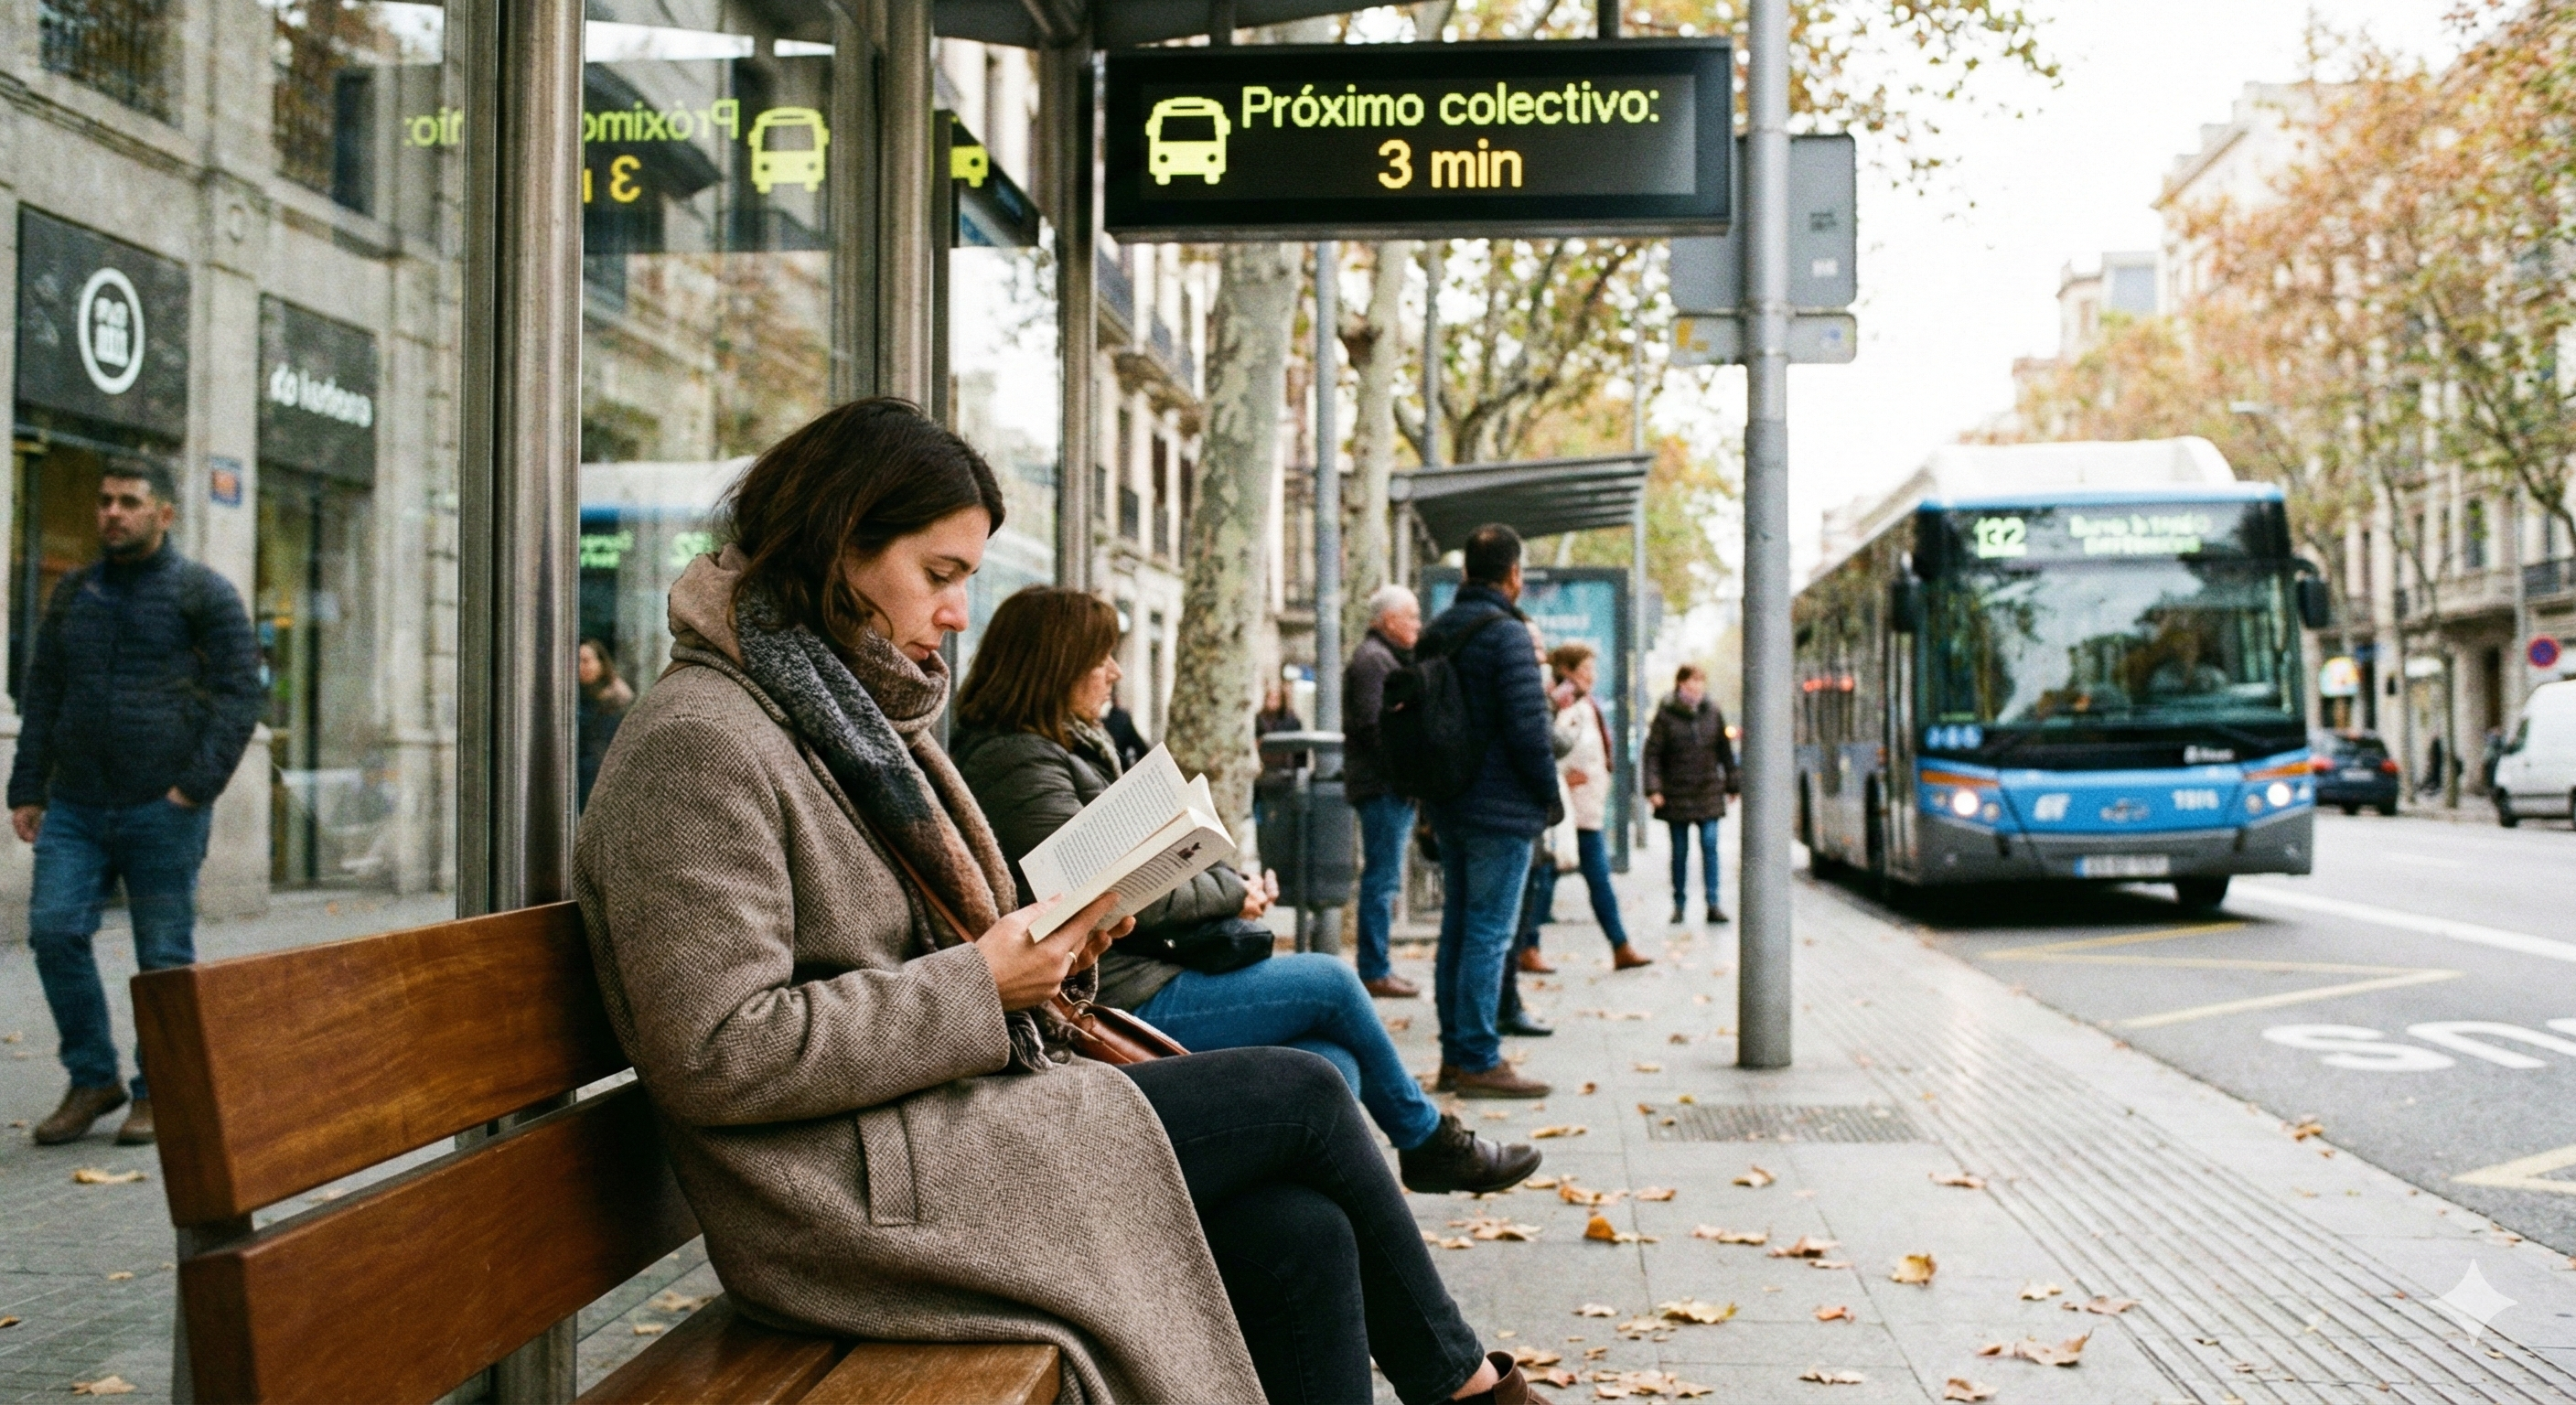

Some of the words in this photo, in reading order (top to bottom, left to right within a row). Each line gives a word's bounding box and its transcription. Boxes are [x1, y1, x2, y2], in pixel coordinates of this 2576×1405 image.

[1241, 83, 1425, 129] Próximo
[1438, 80, 1660, 126] colectivo:
[1379, 138, 1413, 190] 3
[1430, 137, 1523, 188] min
[1973, 516, 2028, 559] 132
